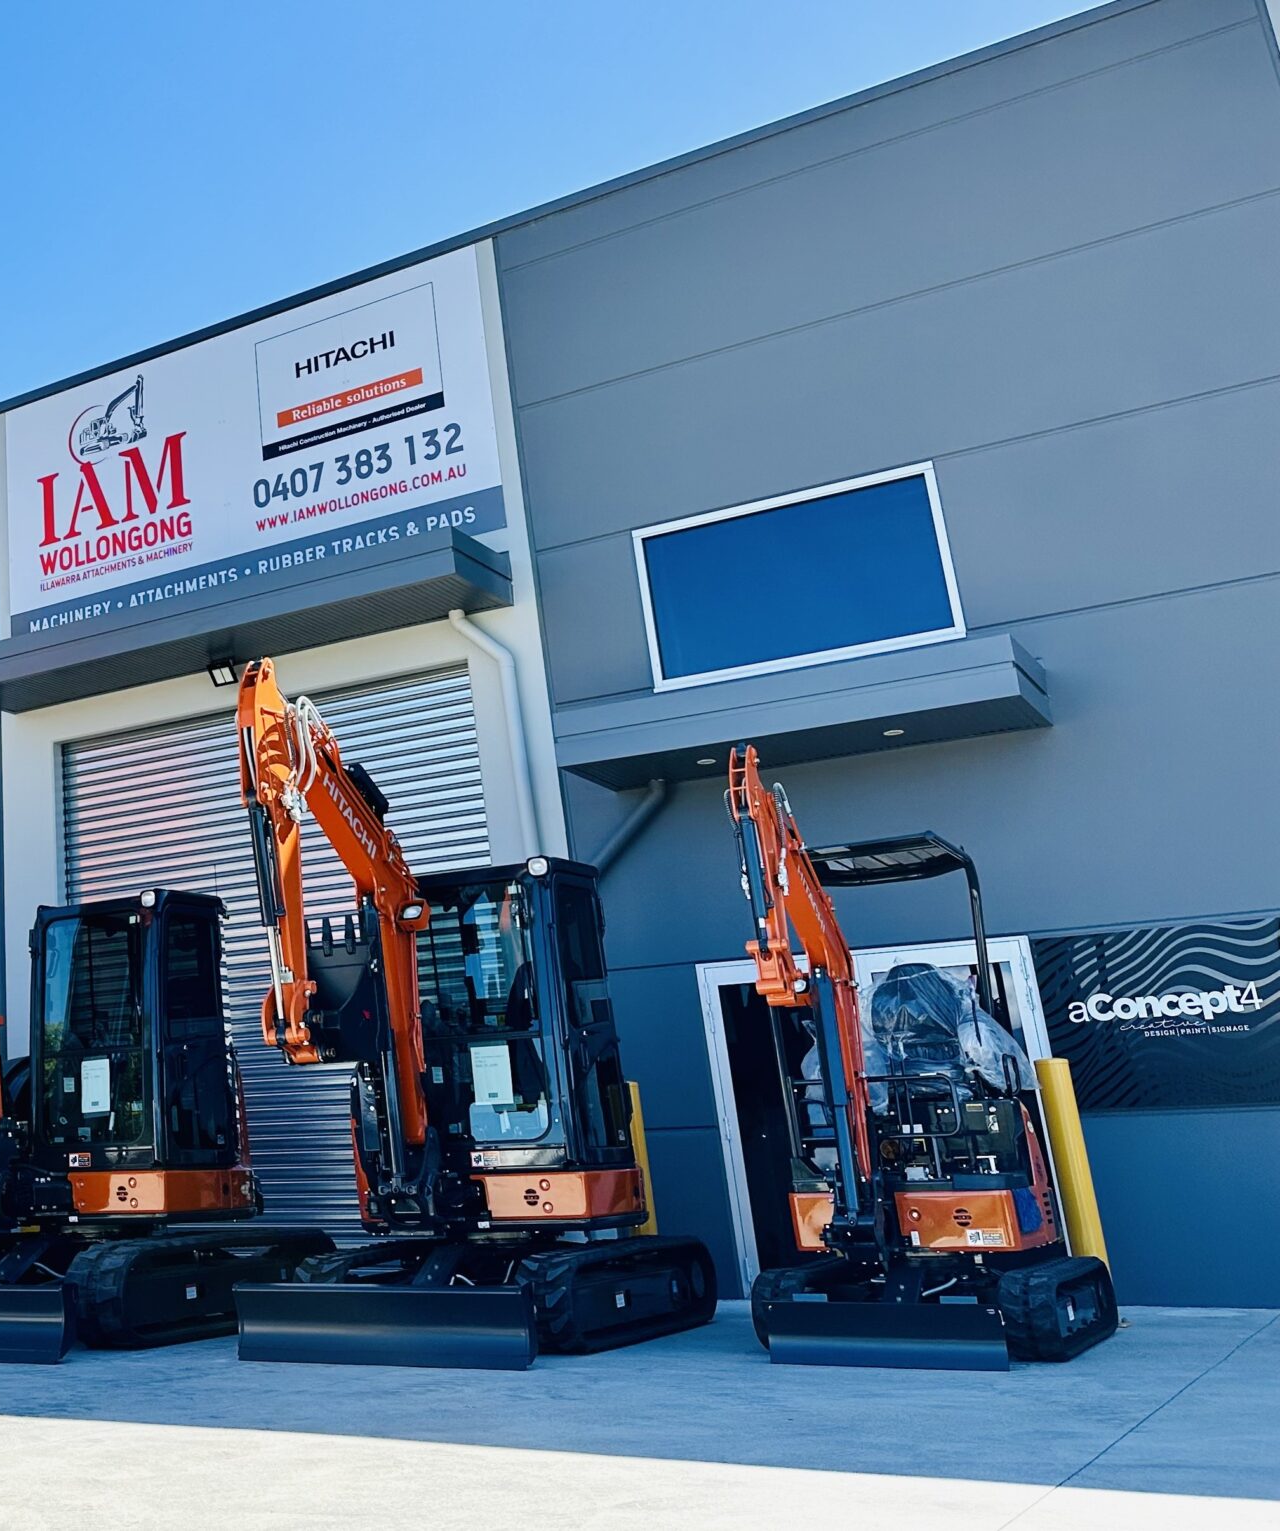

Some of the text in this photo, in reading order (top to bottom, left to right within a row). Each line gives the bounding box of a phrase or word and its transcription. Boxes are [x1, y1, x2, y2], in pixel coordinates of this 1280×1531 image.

[294, 330, 396, 379] HITACHI
[291, 376, 407, 422] Reliable solutions
[278, 440, 299, 451] Hitachi
[299, 429, 336, 445] Construction
[336, 420, 368, 435] Machinery
[372, 409, 405, 423] Authorised
[405, 401, 427, 413] Dealer
[36, 431, 191, 548] IAM
[253, 422, 464, 508] 0407 383 132
[256, 463, 467, 532] WWW.IAMWOLLONGONG.COM.AU
[29, 506, 477, 633] MACHINERY ATTACHMENTS RUBBER TRACKS & PADS
[39, 512, 193, 577] WOLLONGONG
[40, 542, 194, 592] ILLAWARRA ATTACHMENTS & MACHINERY
[322, 772, 377, 860] HITACHI
[1068, 981, 1264, 1024] aConcept4
[1120, 1018, 1207, 1031] creative
[1211, 1024, 1250, 1033] SIGNAGE
